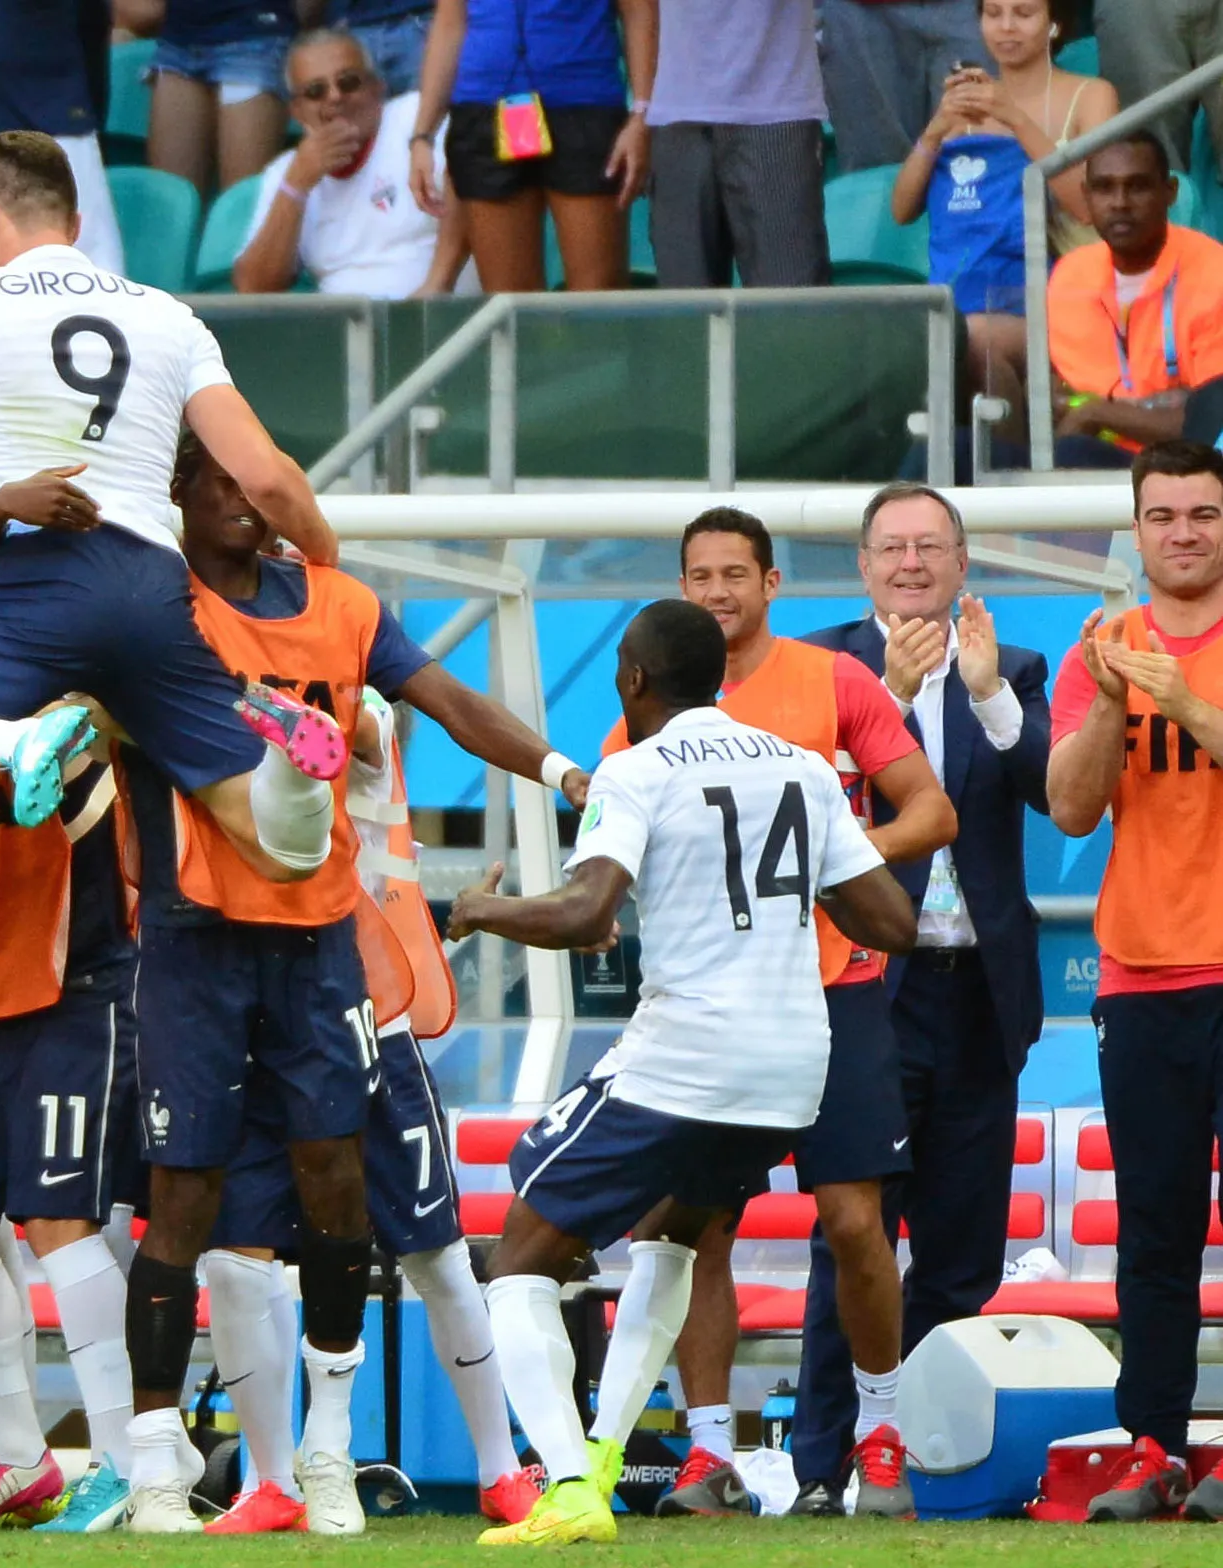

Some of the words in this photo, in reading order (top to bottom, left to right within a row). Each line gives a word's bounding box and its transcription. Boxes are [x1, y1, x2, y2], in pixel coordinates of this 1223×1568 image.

[50, 314, 132, 442] 9
[701, 781, 811, 931] 14
[40, 1094, 86, 1158] 11
[402, 1124, 431, 1191] 7
